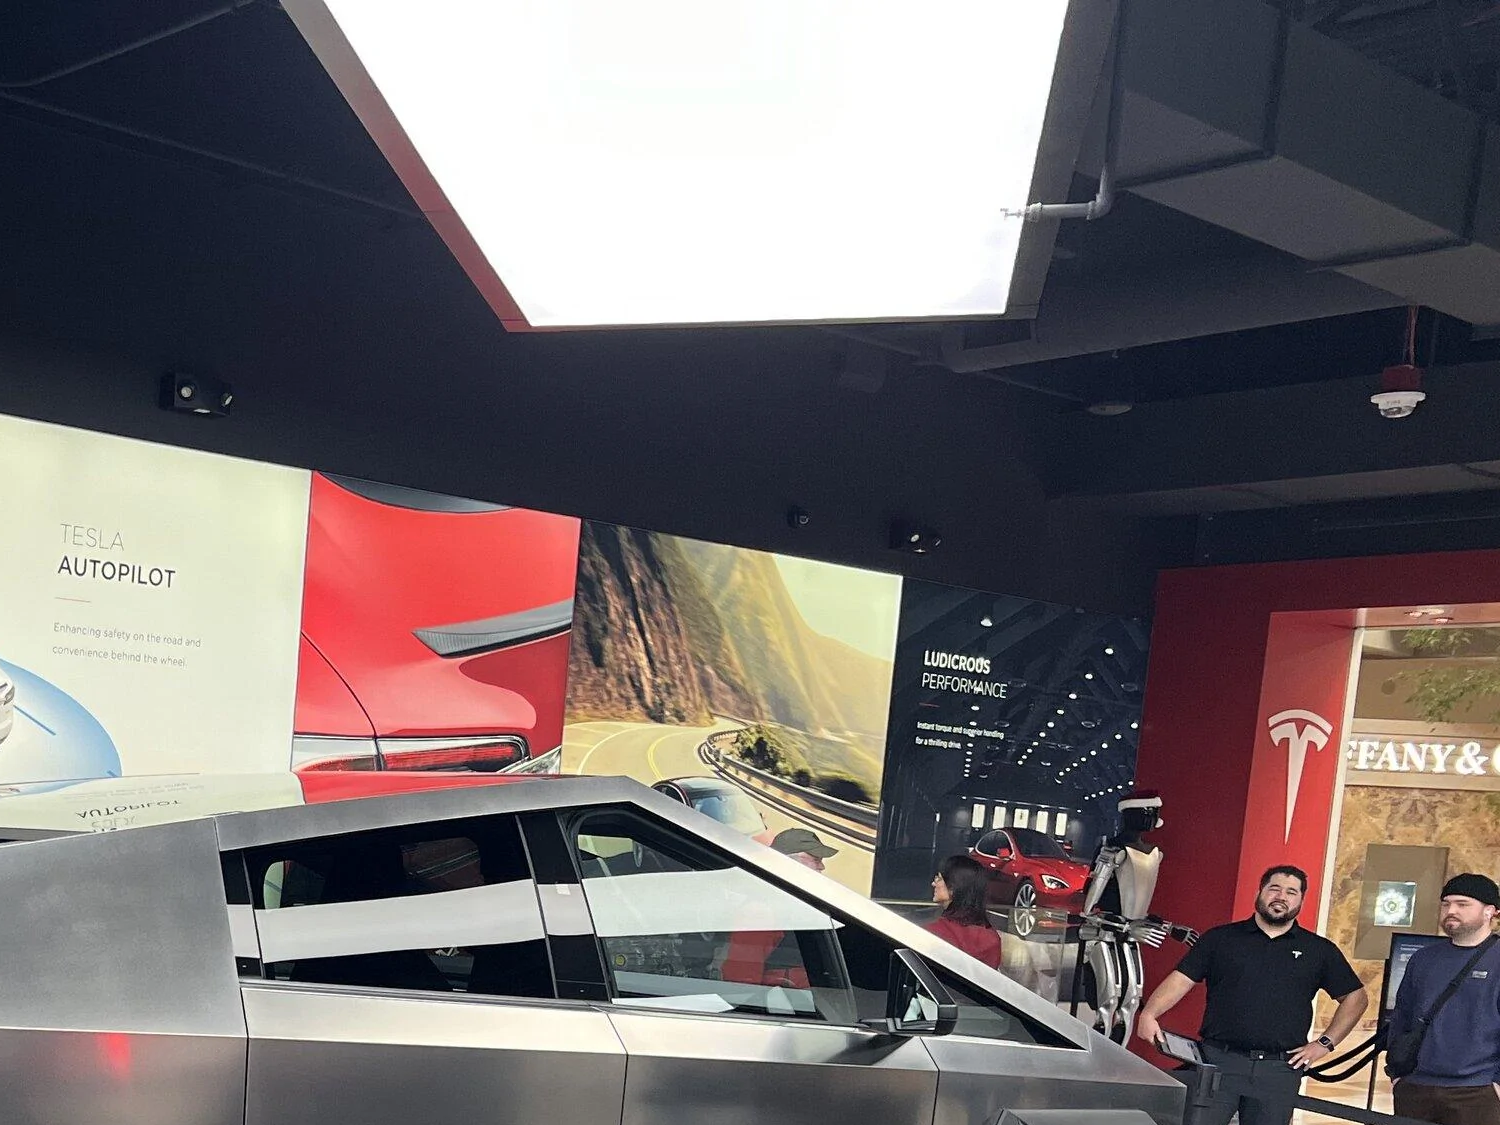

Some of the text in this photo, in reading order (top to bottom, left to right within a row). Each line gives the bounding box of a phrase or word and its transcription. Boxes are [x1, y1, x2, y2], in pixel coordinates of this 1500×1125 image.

[60, 523, 125, 551] TESLA
[57, 555, 176, 588] AUTOPILOT
[53, 622, 201, 648] Enhancing safety on the road and
[52, 645, 109, 659] convenience
[111, 649, 141, 662] behind
[143, 653, 158, 664] the
[924, 650, 991, 675] LUDICROUS
[921, 672, 1008, 699] PERFORMANCE
[1455, 741, 1489, 775] &
